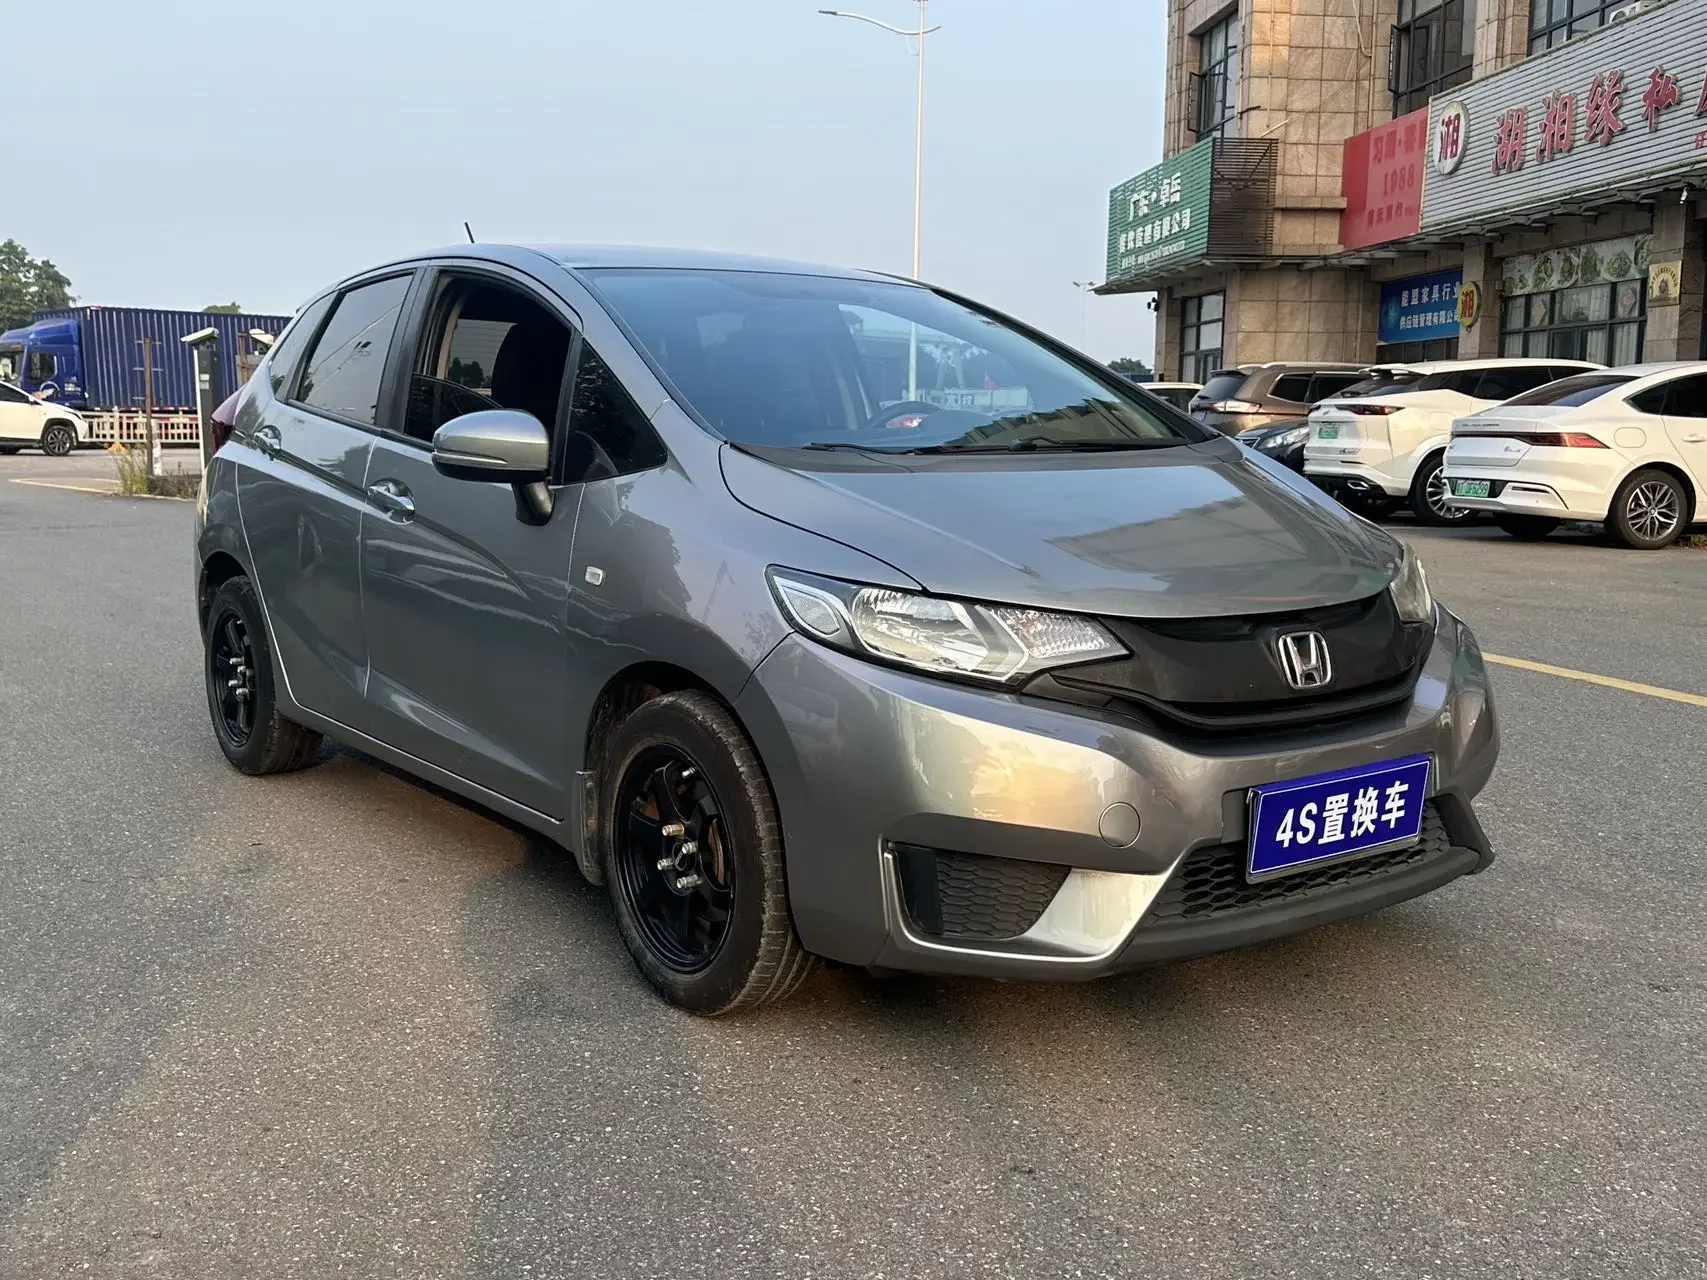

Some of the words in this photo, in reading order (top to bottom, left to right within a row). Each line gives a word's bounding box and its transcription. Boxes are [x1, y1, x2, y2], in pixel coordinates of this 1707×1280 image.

[1438, 112, 1461, 163] 湘
[1491, 68, 1707, 176] 湖湘缘私
[1383, 163, 1415, 197] 1988
[1275, 780, 1409, 848] 4S置换车
